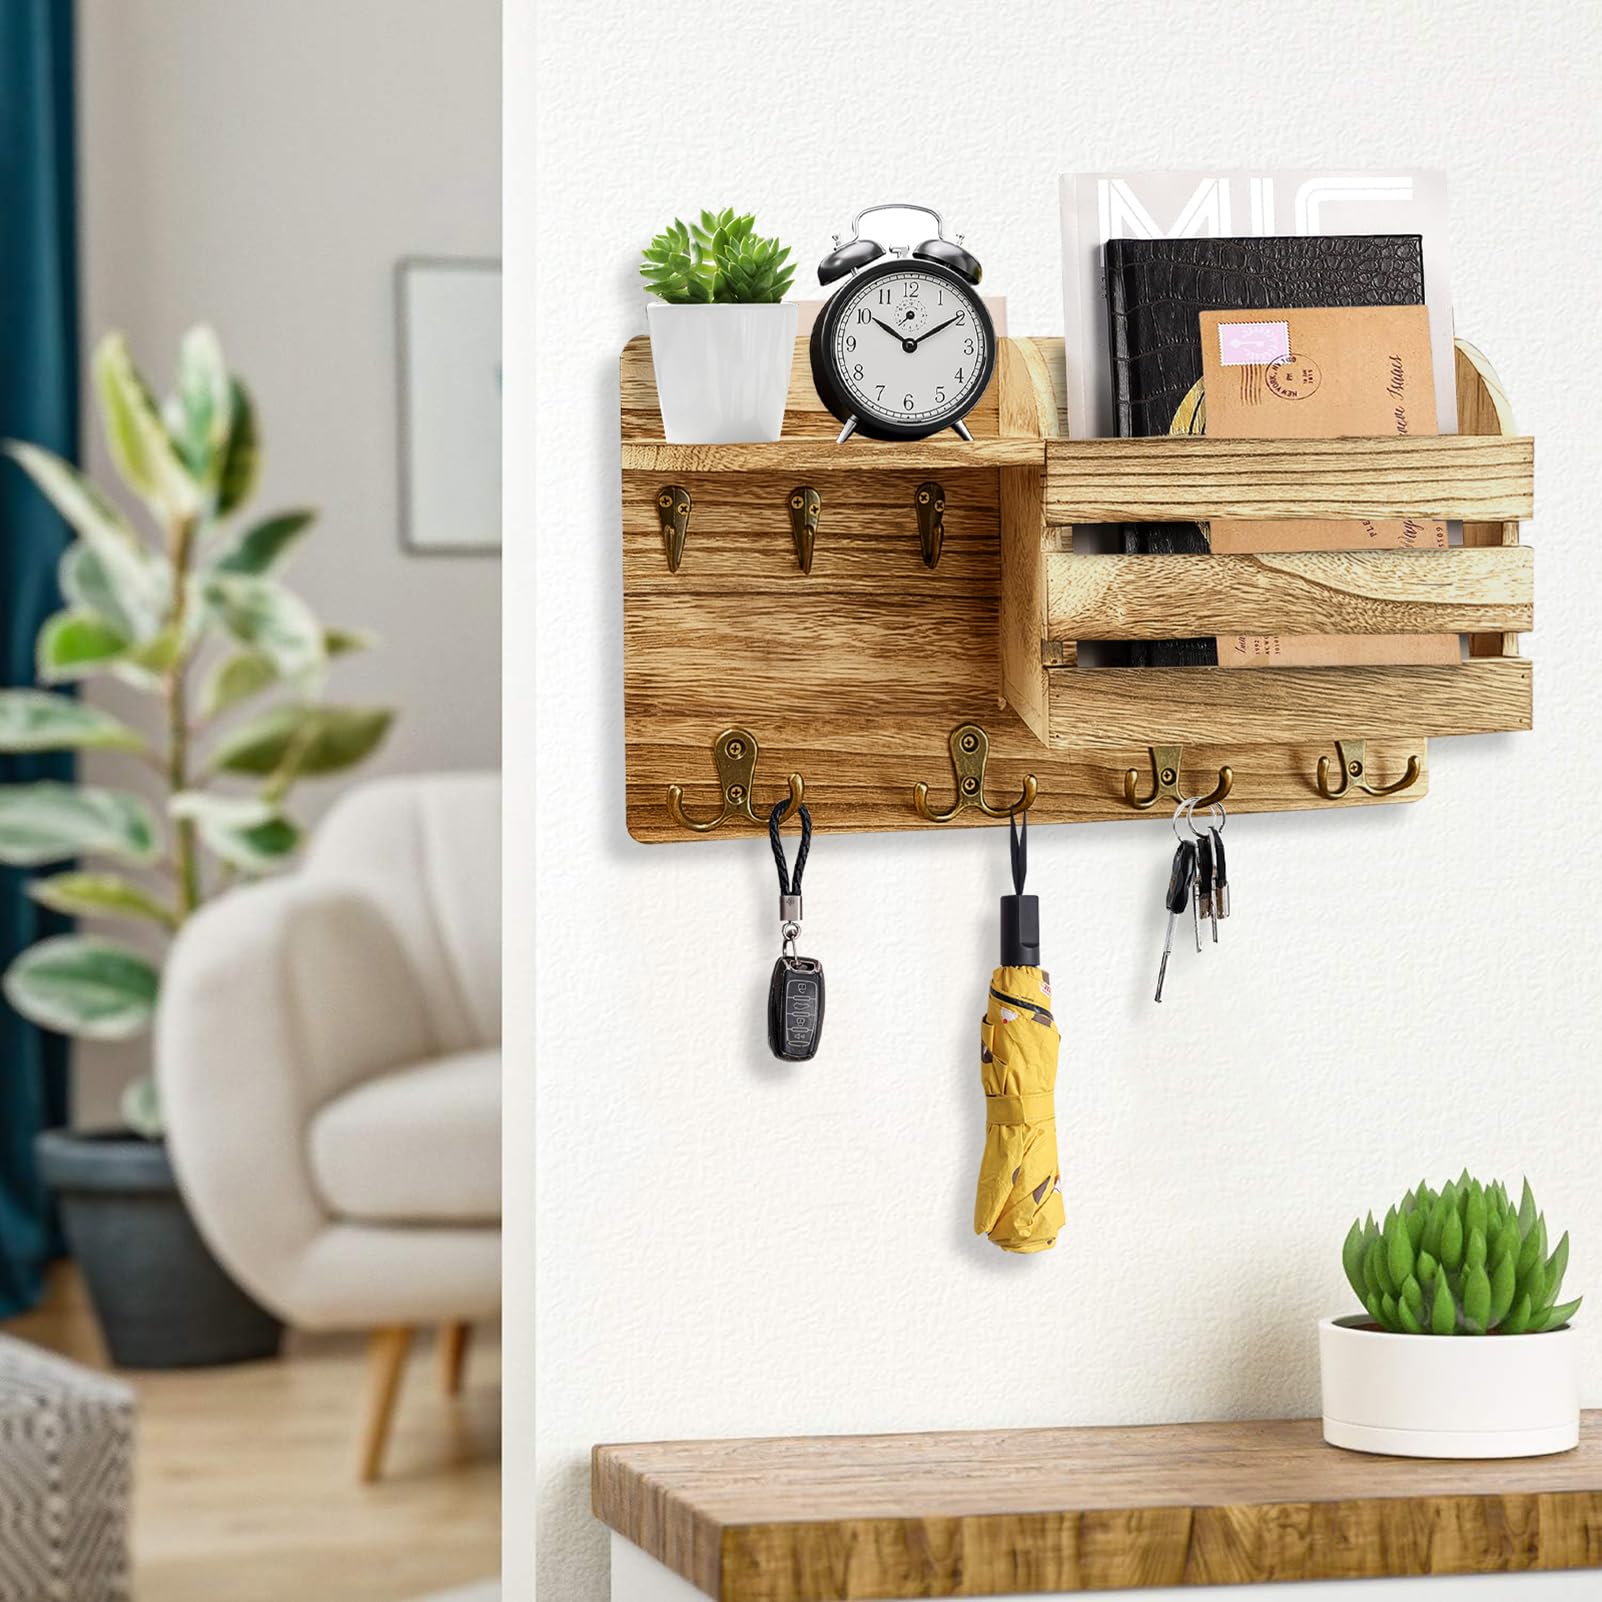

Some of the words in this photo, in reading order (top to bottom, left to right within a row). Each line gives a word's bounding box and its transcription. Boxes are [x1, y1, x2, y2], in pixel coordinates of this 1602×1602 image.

[879, 289, 890, 304] 11
[903, 282, 919, 297] 12
[938, 290, 944, 305] 1
[857, 308, 872, 323] 10
[956, 310, 965, 326] 2
[846, 336, 856, 352] 9
[964, 339, 974, 355] 3
[853, 364, 864, 380] 8
[955, 368, 964, 383] 4
[876, 385, 885, 401] 7
[935, 386, 945, 403] 5
[904, 394, 913, 410] 6
